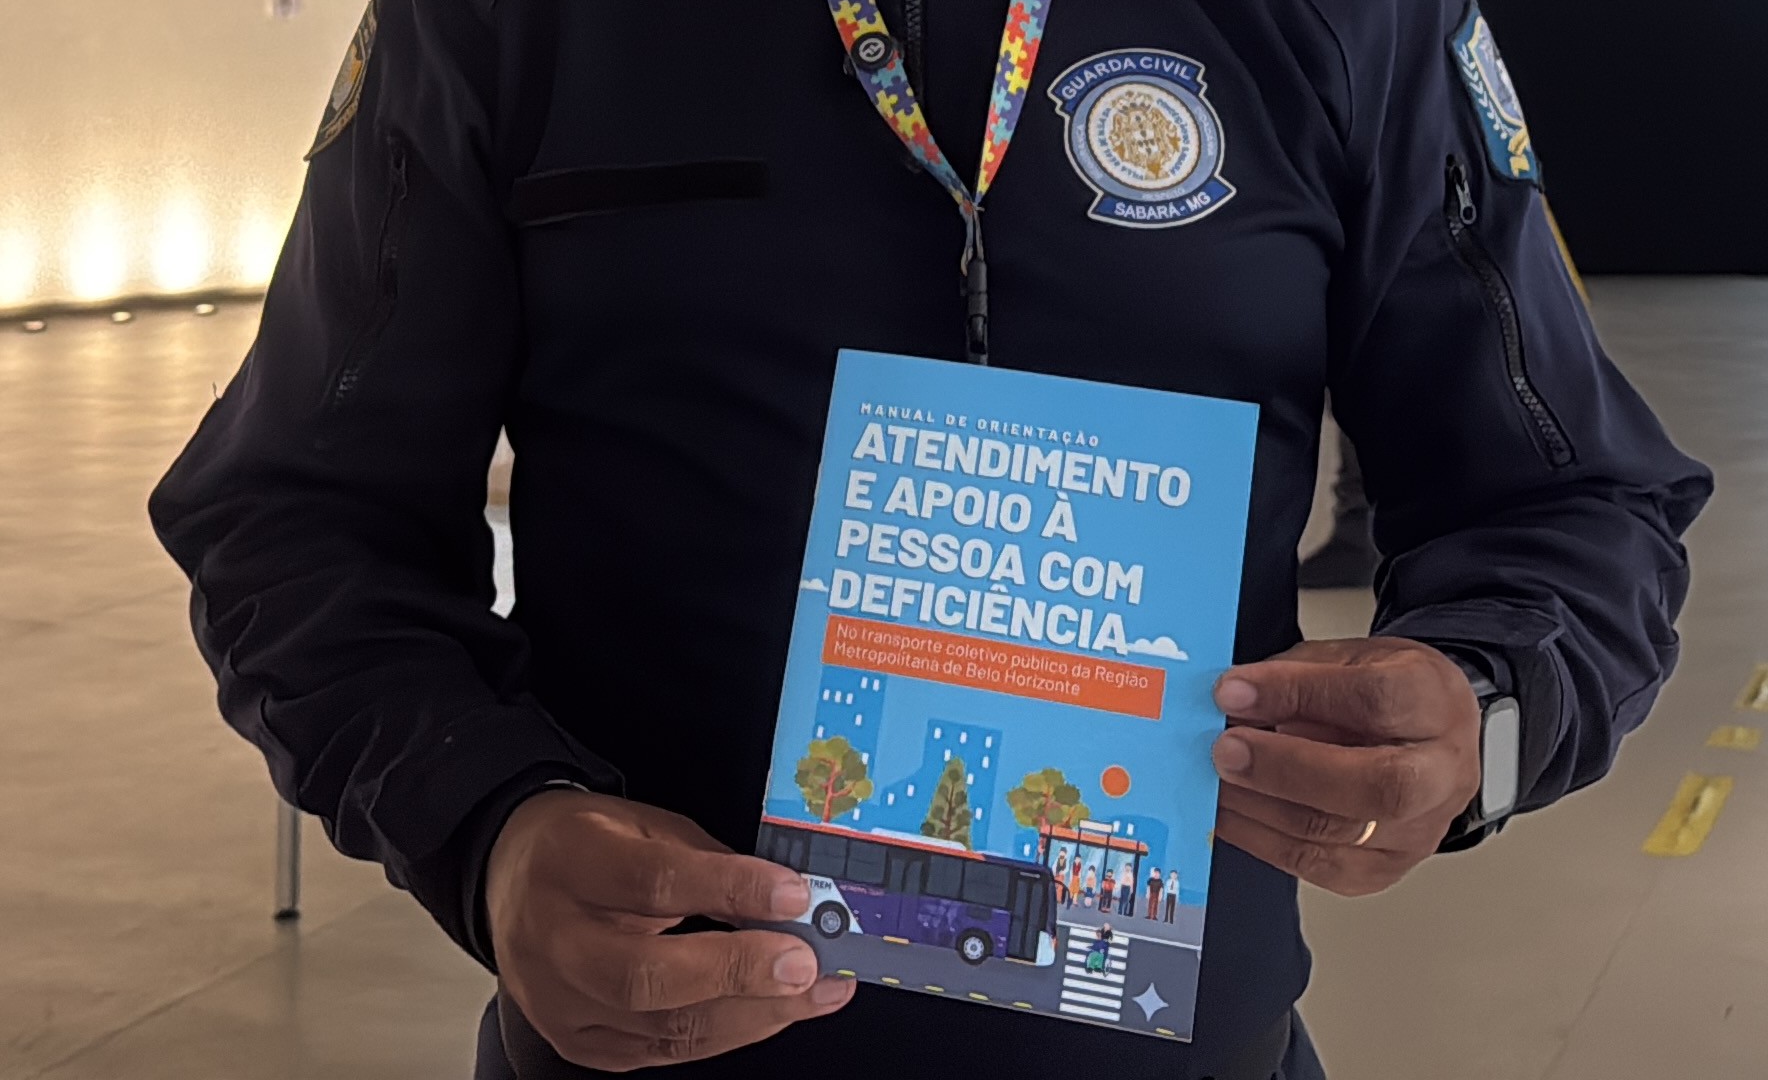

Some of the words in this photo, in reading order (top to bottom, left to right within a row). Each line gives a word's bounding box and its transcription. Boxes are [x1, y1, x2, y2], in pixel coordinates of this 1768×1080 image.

[1061, 57, 1136, 100] GUARDA
[1139, 56, 1192, 81] CIVIL
[860, 402, 935, 423] MANUAL
[945, 413, 968, 428] DE
[977, 418, 1099, 448] ORIENTAÇÃO
[852, 421, 1192, 508] ATENDIMENTO
[844, 470, 877, 510] E
[883, 476, 1032, 533] APOIO
[1040, 491, 1078, 543] À
[836, 519, 1025, 586] PESSOA
[1039, 551, 1144, 605] COM
[828, 567, 1128, 656] DEFICIÊNCIA
[833, 641, 939, 672] Metropolitana
[942, 660, 963, 674] de
[965, 662, 1001, 683] Belo
[1004, 669, 1081, 696] Horizonte
[836, 623, 858, 639] No
[861, 627, 942, 654] transporte
[945, 644, 1008, 664] coletivo
[1010, 654, 1068, 676] público
[1071, 663, 1091, 680] da
[1095, 665, 1149, 689] Região
